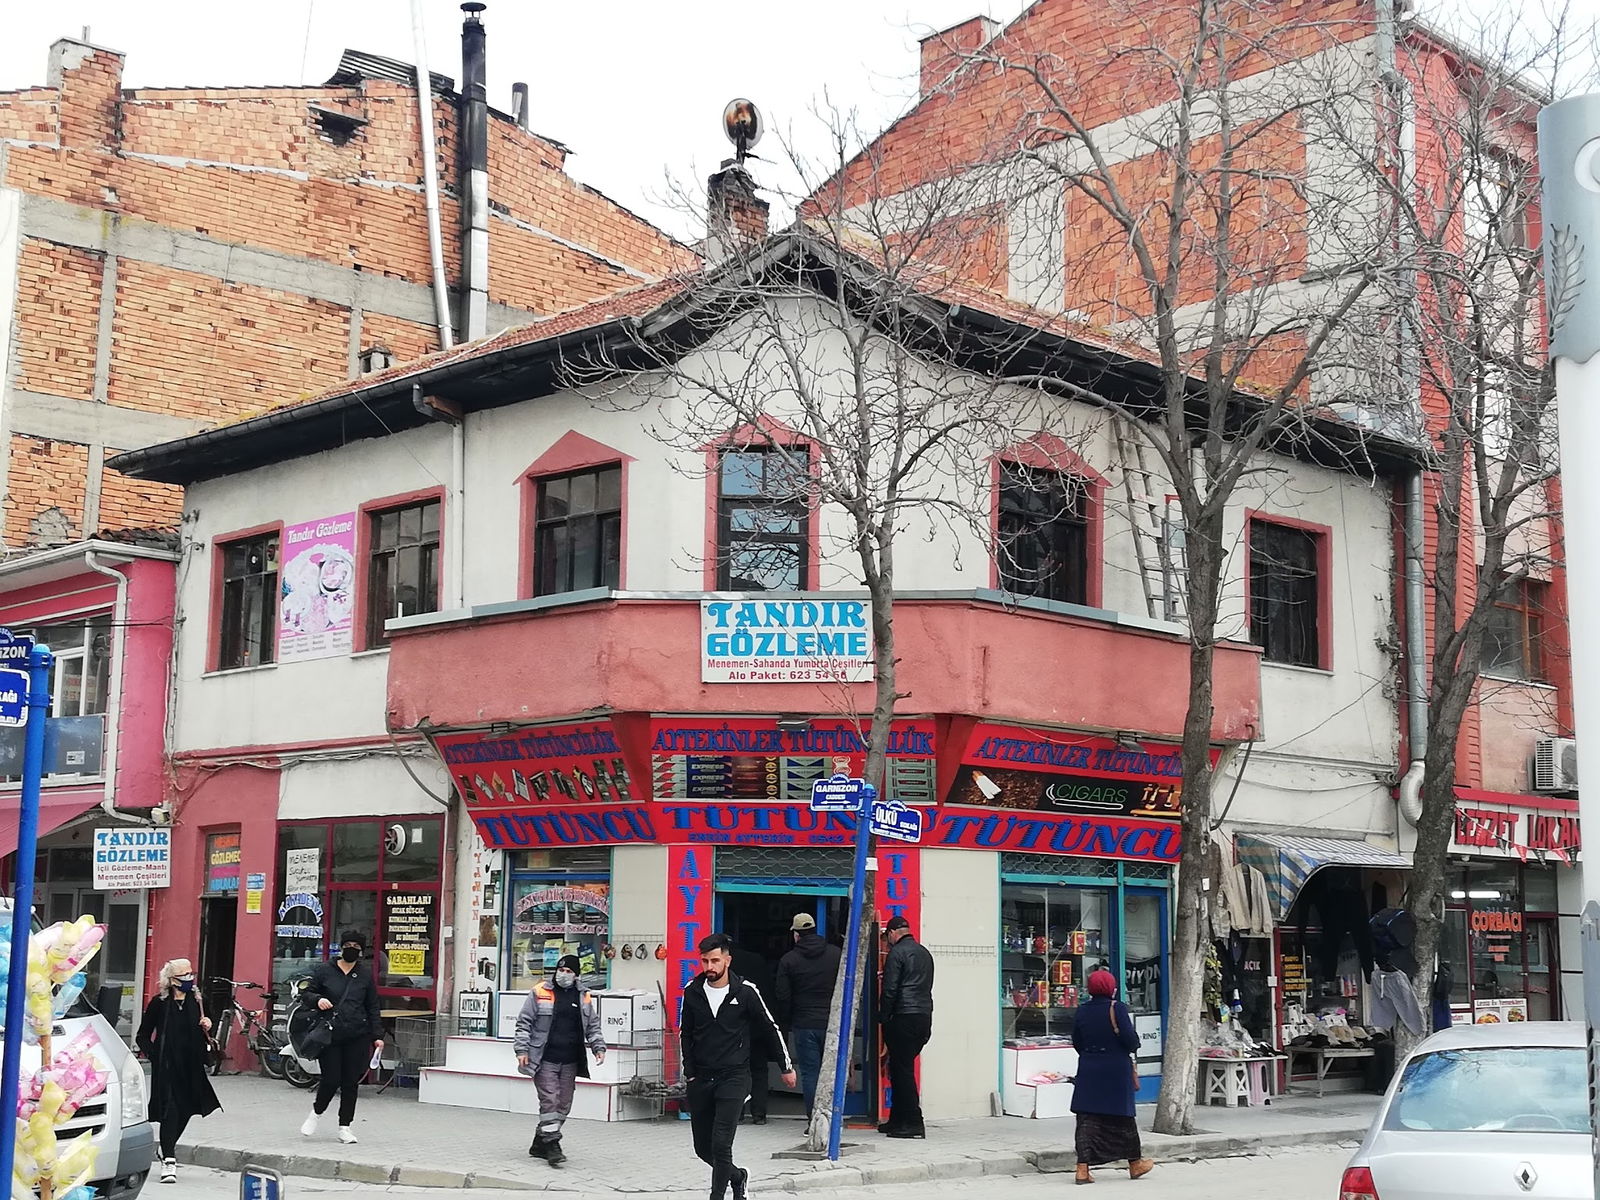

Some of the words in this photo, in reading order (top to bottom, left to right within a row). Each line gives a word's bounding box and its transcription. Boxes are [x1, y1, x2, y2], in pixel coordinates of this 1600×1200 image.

[316, 520, 353, 538] Gözleme
[707, 602, 866, 627] TANDIR
[707, 628, 867, 657] GÖZLEME
[708, 659, 792, 668] Menemen-Sahanda
[729, 671, 747, 680] Alo
[751, 671, 785, 680] Paket:
[789, 671, 811, 680] 623
[815, 671, 829, 680] 54
[653, 722, 785, 752] AYTEKİNLER
[973, 736, 1090, 769] AYTEKİNLER
[1055, 783, 1129, 804] CIGARS
[875, 806, 898, 826] ÜLKÜ
[1455, 808, 1520, 848] LEZZET
[97, 832, 168, 846] TANDIR
[97, 847, 168, 862] GÖZLEME
